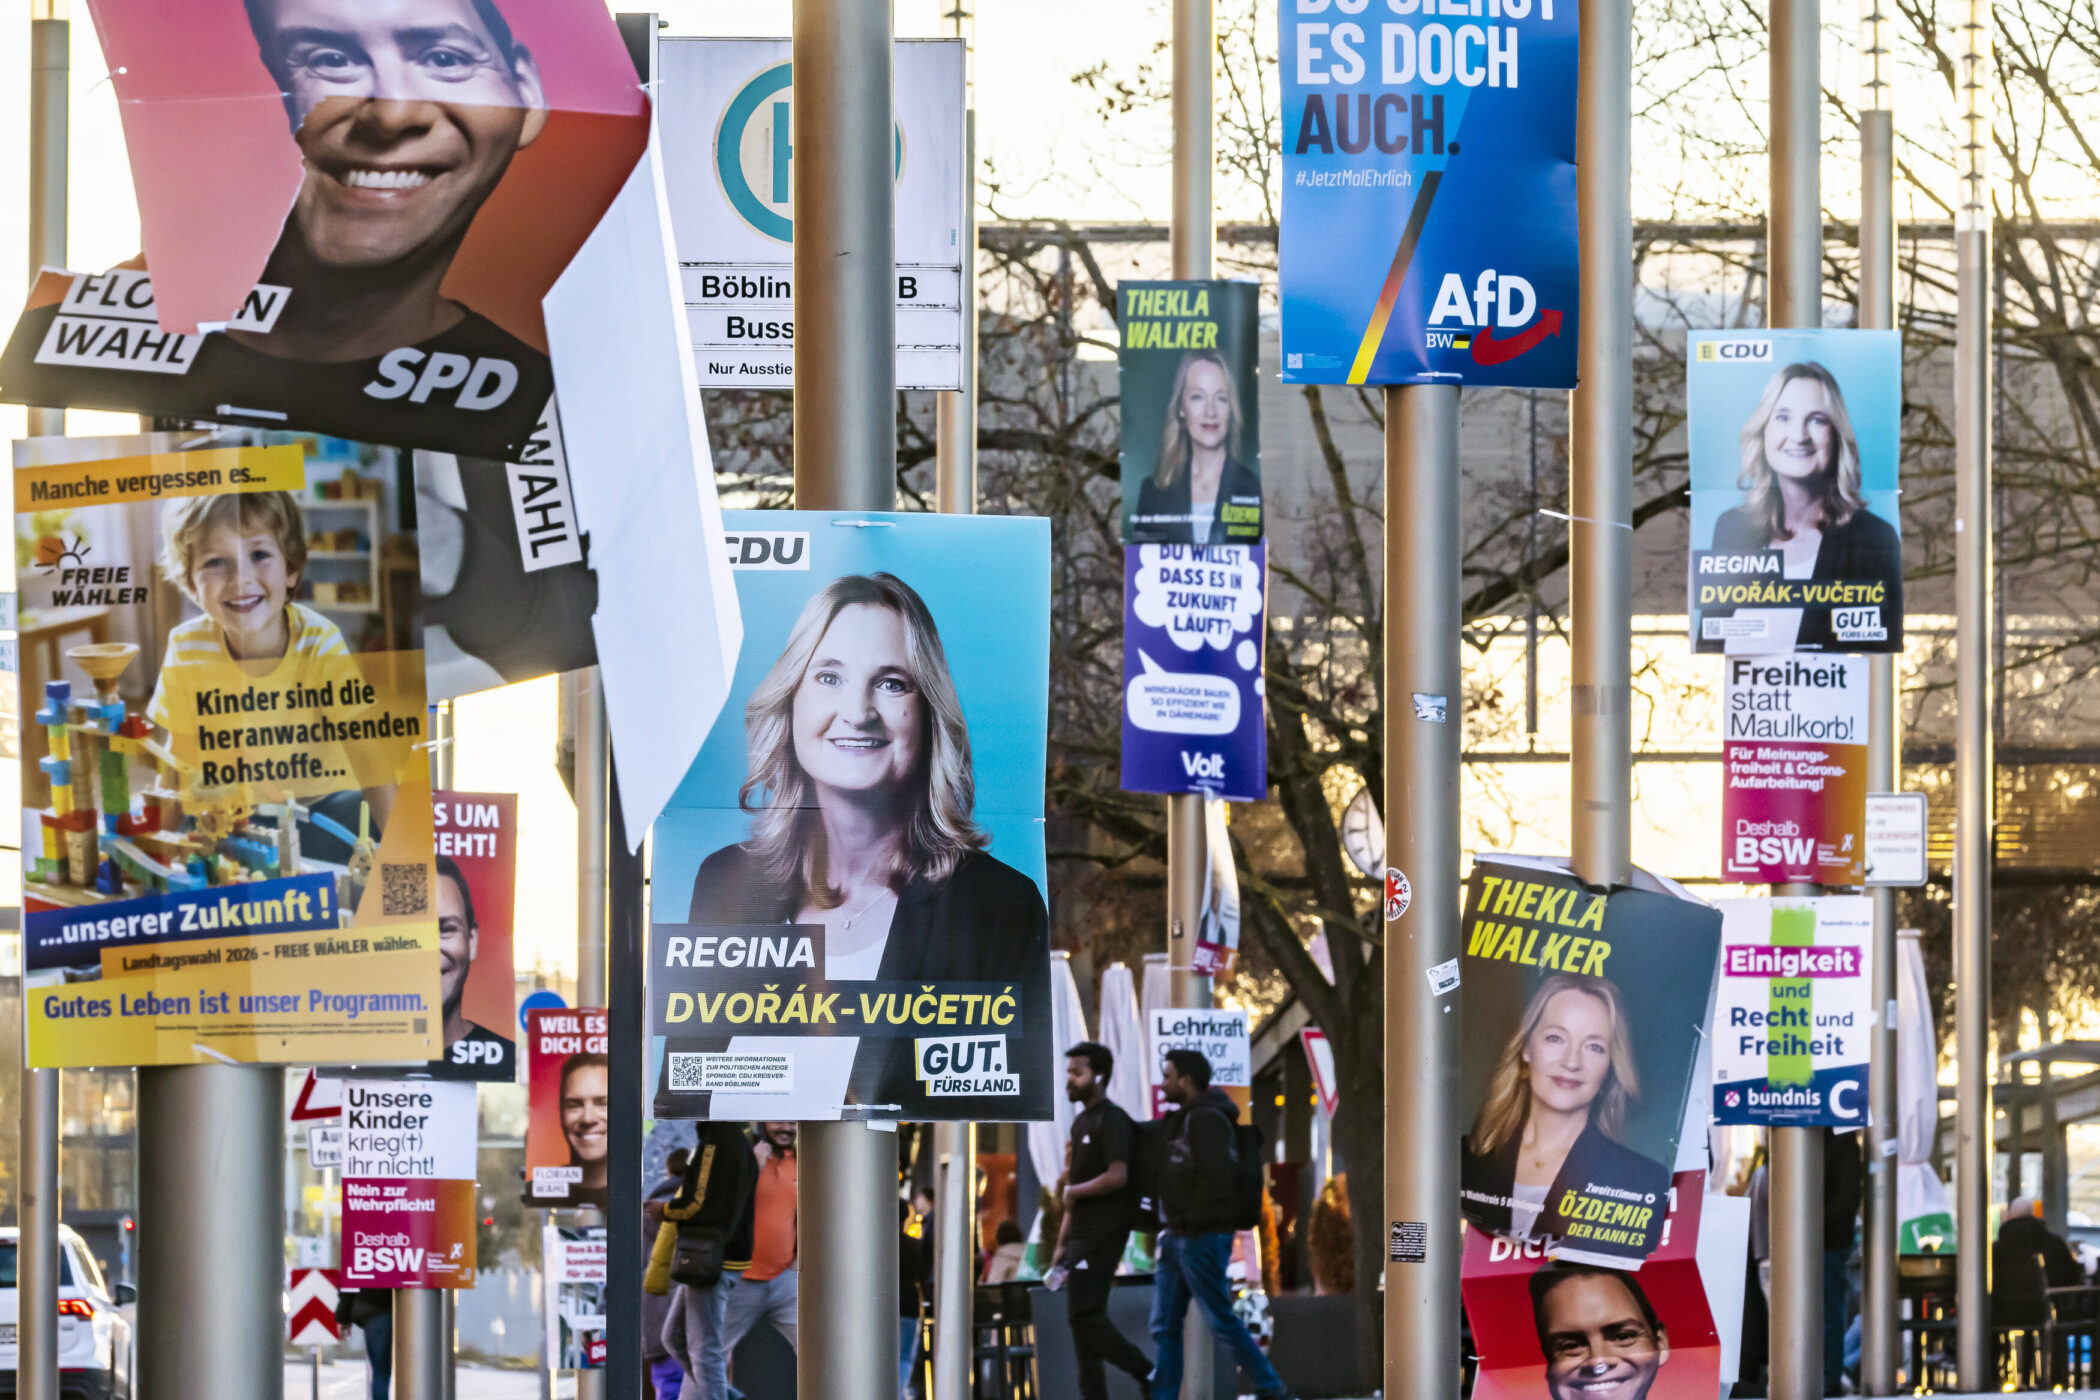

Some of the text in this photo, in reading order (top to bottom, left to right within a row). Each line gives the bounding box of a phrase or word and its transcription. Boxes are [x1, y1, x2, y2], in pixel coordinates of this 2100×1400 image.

[1297, 22, 1518, 88] ES DOCH
[1295, 93, 1461, 156] AUCH.
[1295, 168, 1412, 187] #JetztMalEhrlich
[74, 273, 278, 323] FLON
[702, 275, 792, 299] Böblin
[1427, 268, 1537, 328] AfD
[1126, 289, 1210, 318] THEKLA
[727, 316, 795, 339] Buss
[1126, 321, 1219, 350] WALKER
[55, 322, 187, 366] WAHL
[1425, 333, 1454, 349] BW
[1720, 344, 1768, 358] CDU
[364, 347, 518, 411] SPD
[709, 363, 793, 375] Nur Ausstie
[30, 466, 268, 502] Manche vergessen es...
[1159, 545, 1184, 560] DU
[1699, 555, 1780, 574] REGINA
[61, 567, 130, 585] FREIE
[1160, 568, 1242, 590] DASS ES IN
[52, 585, 148, 607] WÄHLER
[1167, 592, 1237, 612] ZUKUNFT
[1174, 611, 1231, 635] LÄUFT?
[1836, 611, 1878, 629] GUT.
[1732, 661, 1847, 688] Freiheit
[196, 678, 375, 716] Kinder sind die
[1732, 689, 1792, 711] statt
[199, 711, 421, 751] heranwachsenden
[1731, 713, 1854, 740] Maulkorb!
[1181, 750, 1225, 778] Volt
[1730, 747, 1829, 763] Für Meinungs-
[202, 752, 346, 786] Rohstoffe...
[1731, 763, 1846, 776] freiheit & Corona-
[1730, 777, 1824, 791] Aufarbeitung!
[455, 803, 499, 829] UM
[1736, 820, 1800, 836] Deshalb
[1736, 837, 1815, 866] BSW
[178, 888, 312, 932] Zukunft
[1477, 876, 1608, 931] THEKLA
[122, 950, 221, 971] Landtagswahl
[226, 947, 259, 962] 2026
[274, 944, 311, 959] FREIE
[314, 938, 369, 957] WÄHLER
[373, 937, 422, 952] wählen.
[665, 936, 816, 968] REGINA
[1467, 920, 1612, 977] WALKER
[1730, 948, 1855, 977] Einigkeit
[1773, 983, 1810, 998] und
[44, 989, 429, 1019] Gutes Leben ist unser Programm.
[665, 983, 1017, 1026] DVOŘÁK-VUČETIĆ
[540, 1016, 605, 1033] WEIL ES
[1157, 1016, 1244, 1037] Lehrkraft
[1731, 1006, 1853, 1027] Recht und
[452, 1041, 503, 1065] SPD
[541, 1037, 608, 1053] DICH GE
[1207, 1043, 1228, 1058] vor
[1739, 1034, 1844, 1056] Freiheit
[923, 1041, 1003, 1075] GUT.
[724, 1080, 760, 1088] BÖBLINGEN
[933, 1077, 1017, 1093] FÜRS LAND.
[350, 1089, 432, 1108] Unsere
[1829, 1080, 1859, 1119] C
[350, 1111, 428, 1129] Kinder
[349, 1156, 434, 1175] ihr nicht!
[348, 1184, 407, 1196] Nein zur
[1585, 1182, 1643, 1202] Zweitstimme
[348, 1198, 435, 1213] Wehrpflicht!
[1558, 1189, 1654, 1230] ÖZDEMIR
[355, 1232, 410, 1247] Deshalb
[1567, 1222, 1591, 1239] DER
[1593, 1226, 1627, 1245] KANN
[1628, 1231, 1646, 1247] ES
[355, 1248, 424, 1273] BSW
[1489, 1236, 1559, 1263] DIC
